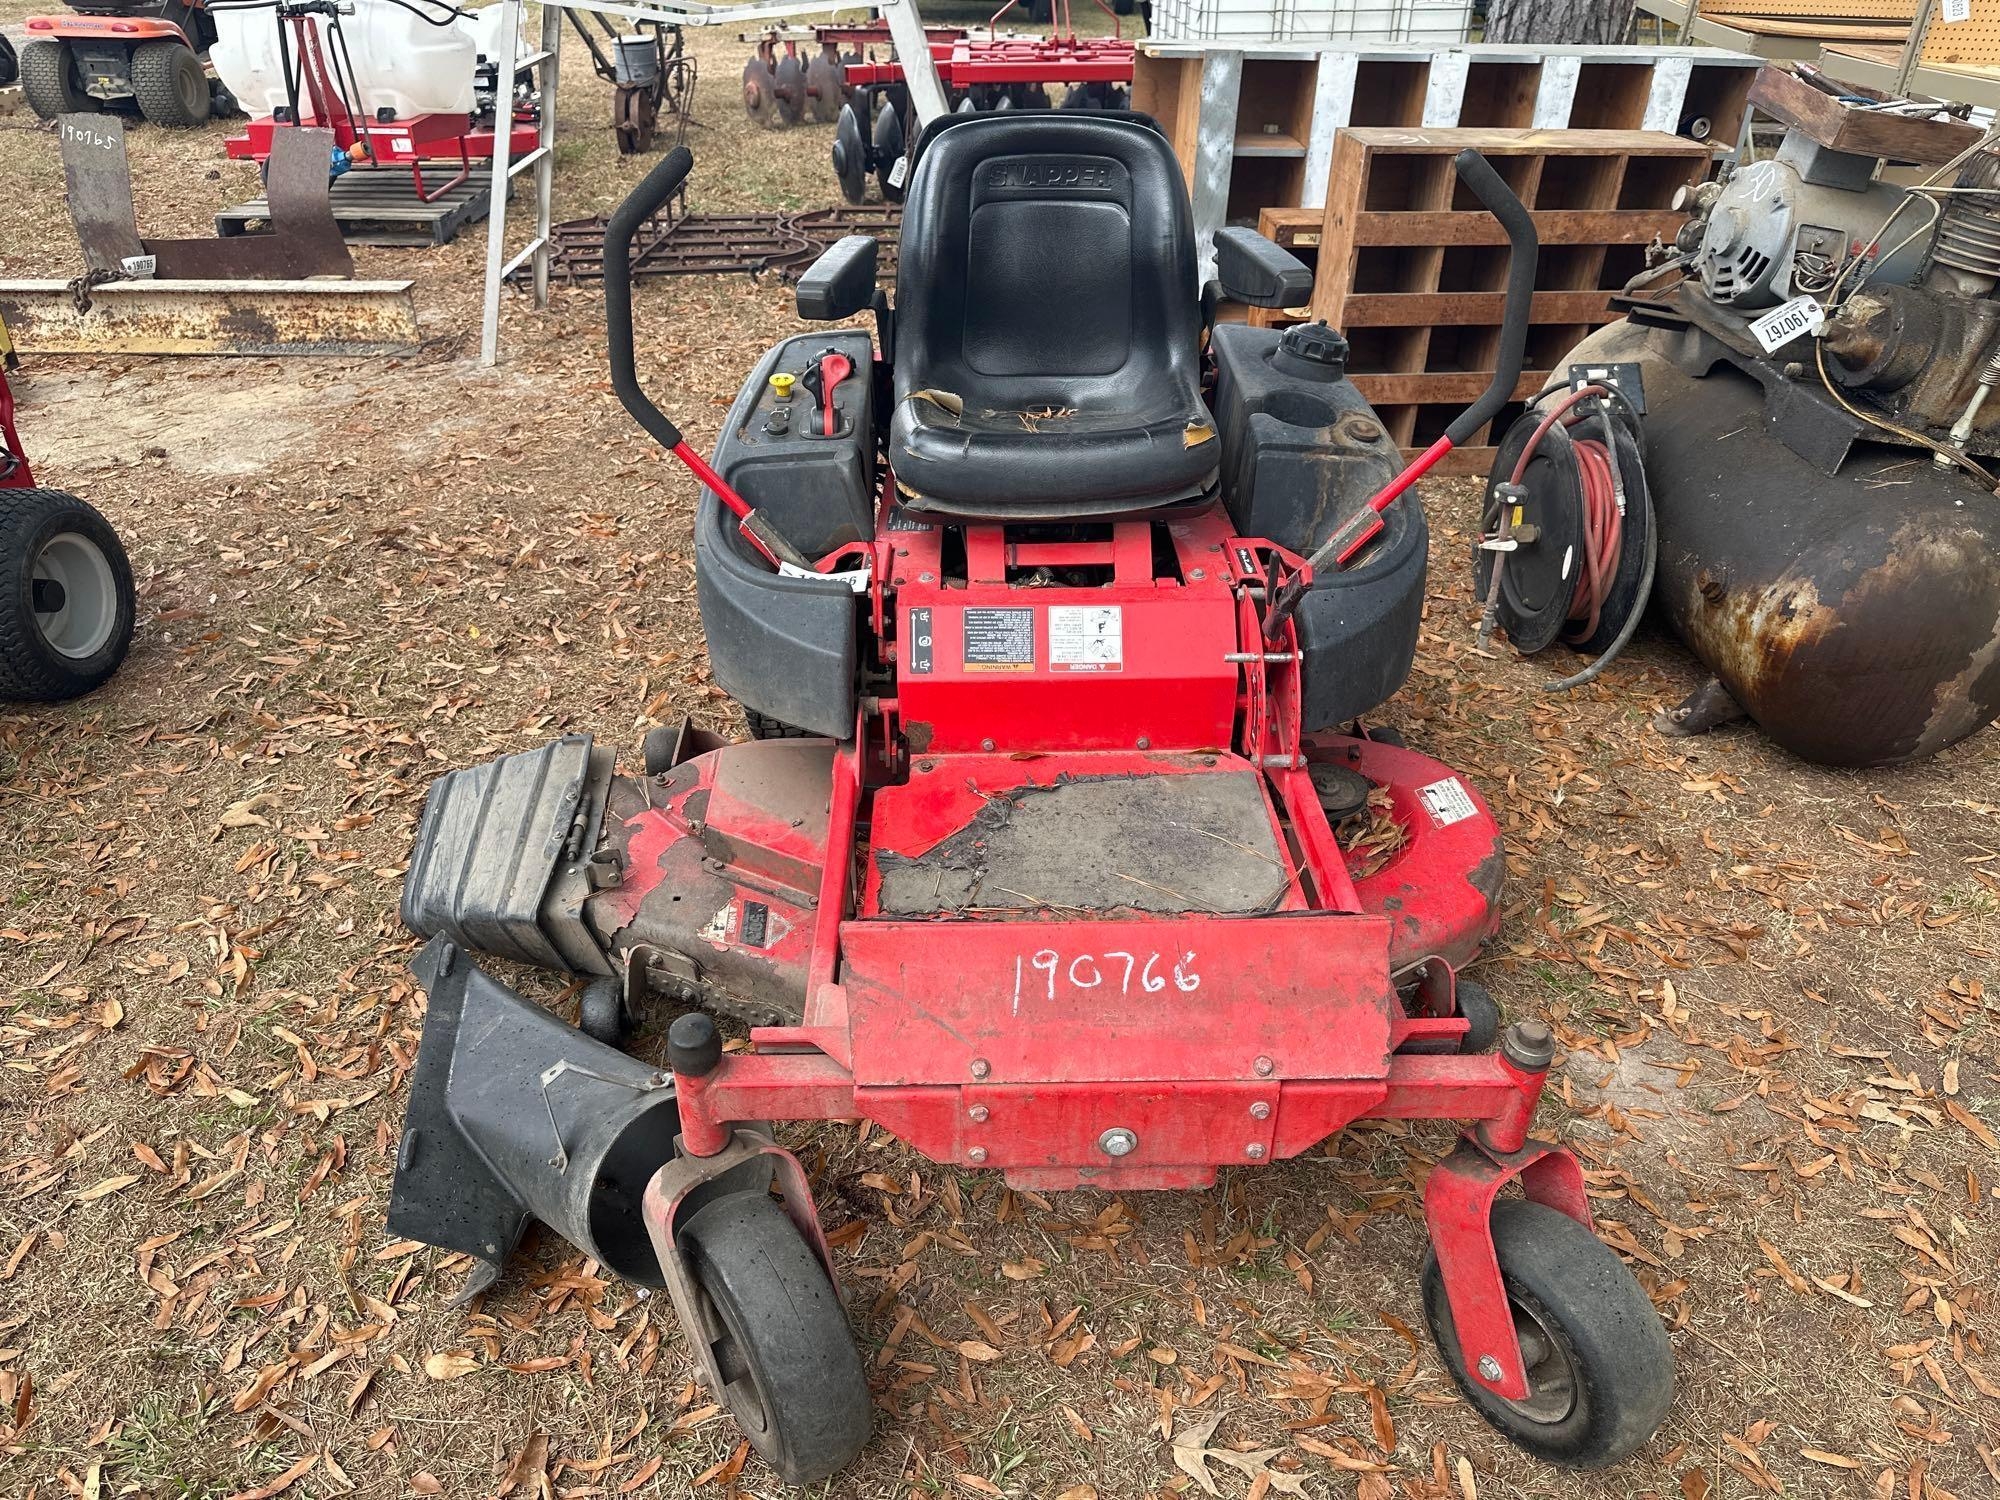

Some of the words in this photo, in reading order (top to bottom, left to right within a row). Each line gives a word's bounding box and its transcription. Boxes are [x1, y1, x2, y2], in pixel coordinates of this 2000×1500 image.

[60, 123, 117, 151] 190765
[988, 164, 1112, 188] SNAPPER
[1765, 310, 1809, 343] 190767
[1069, 662, 1097, 670] DANGER
[1012, 948, 1201, 1019] 190766
